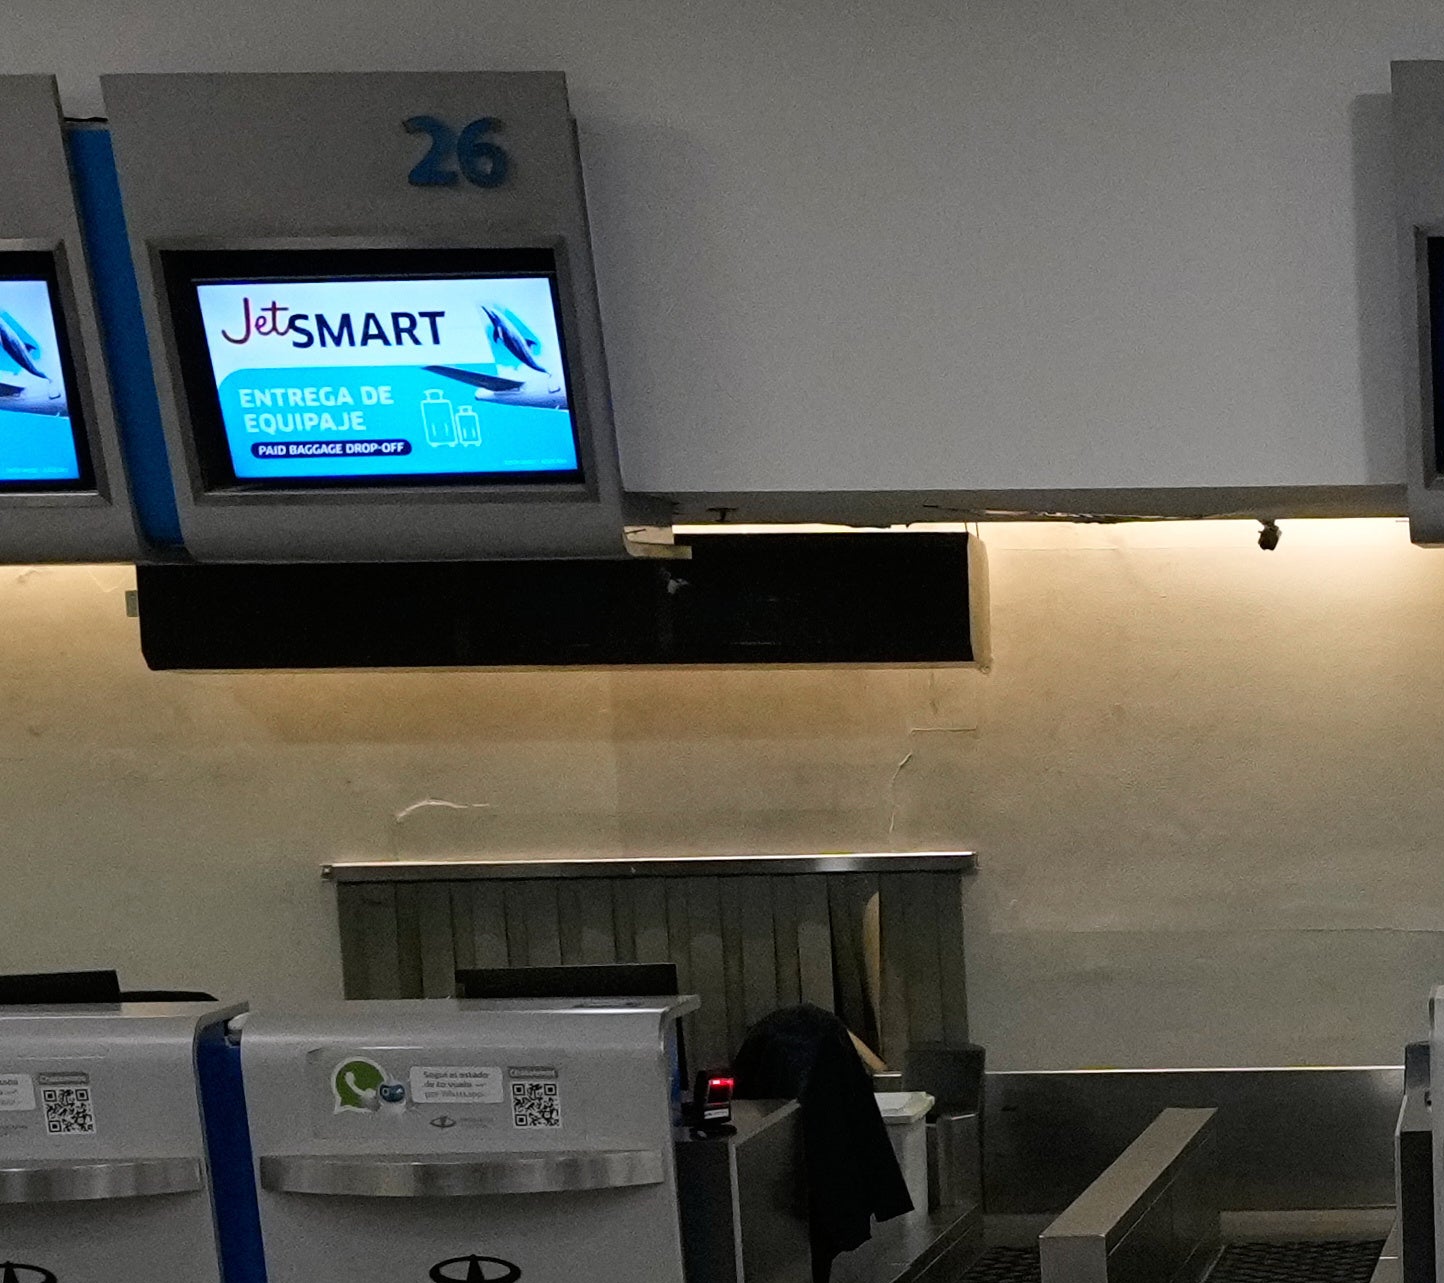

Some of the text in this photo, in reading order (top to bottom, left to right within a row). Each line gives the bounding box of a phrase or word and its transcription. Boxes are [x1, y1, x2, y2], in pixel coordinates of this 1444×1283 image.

[405, 115, 508, 188] 26
[221, 297, 446, 349] JetSMART
[238, 385, 394, 408] ENTREGA DE
[244, 411, 367, 435] EQUIPAJE
[258, 441, 404, 456] PAID BAGGAGE DROP-OFF
